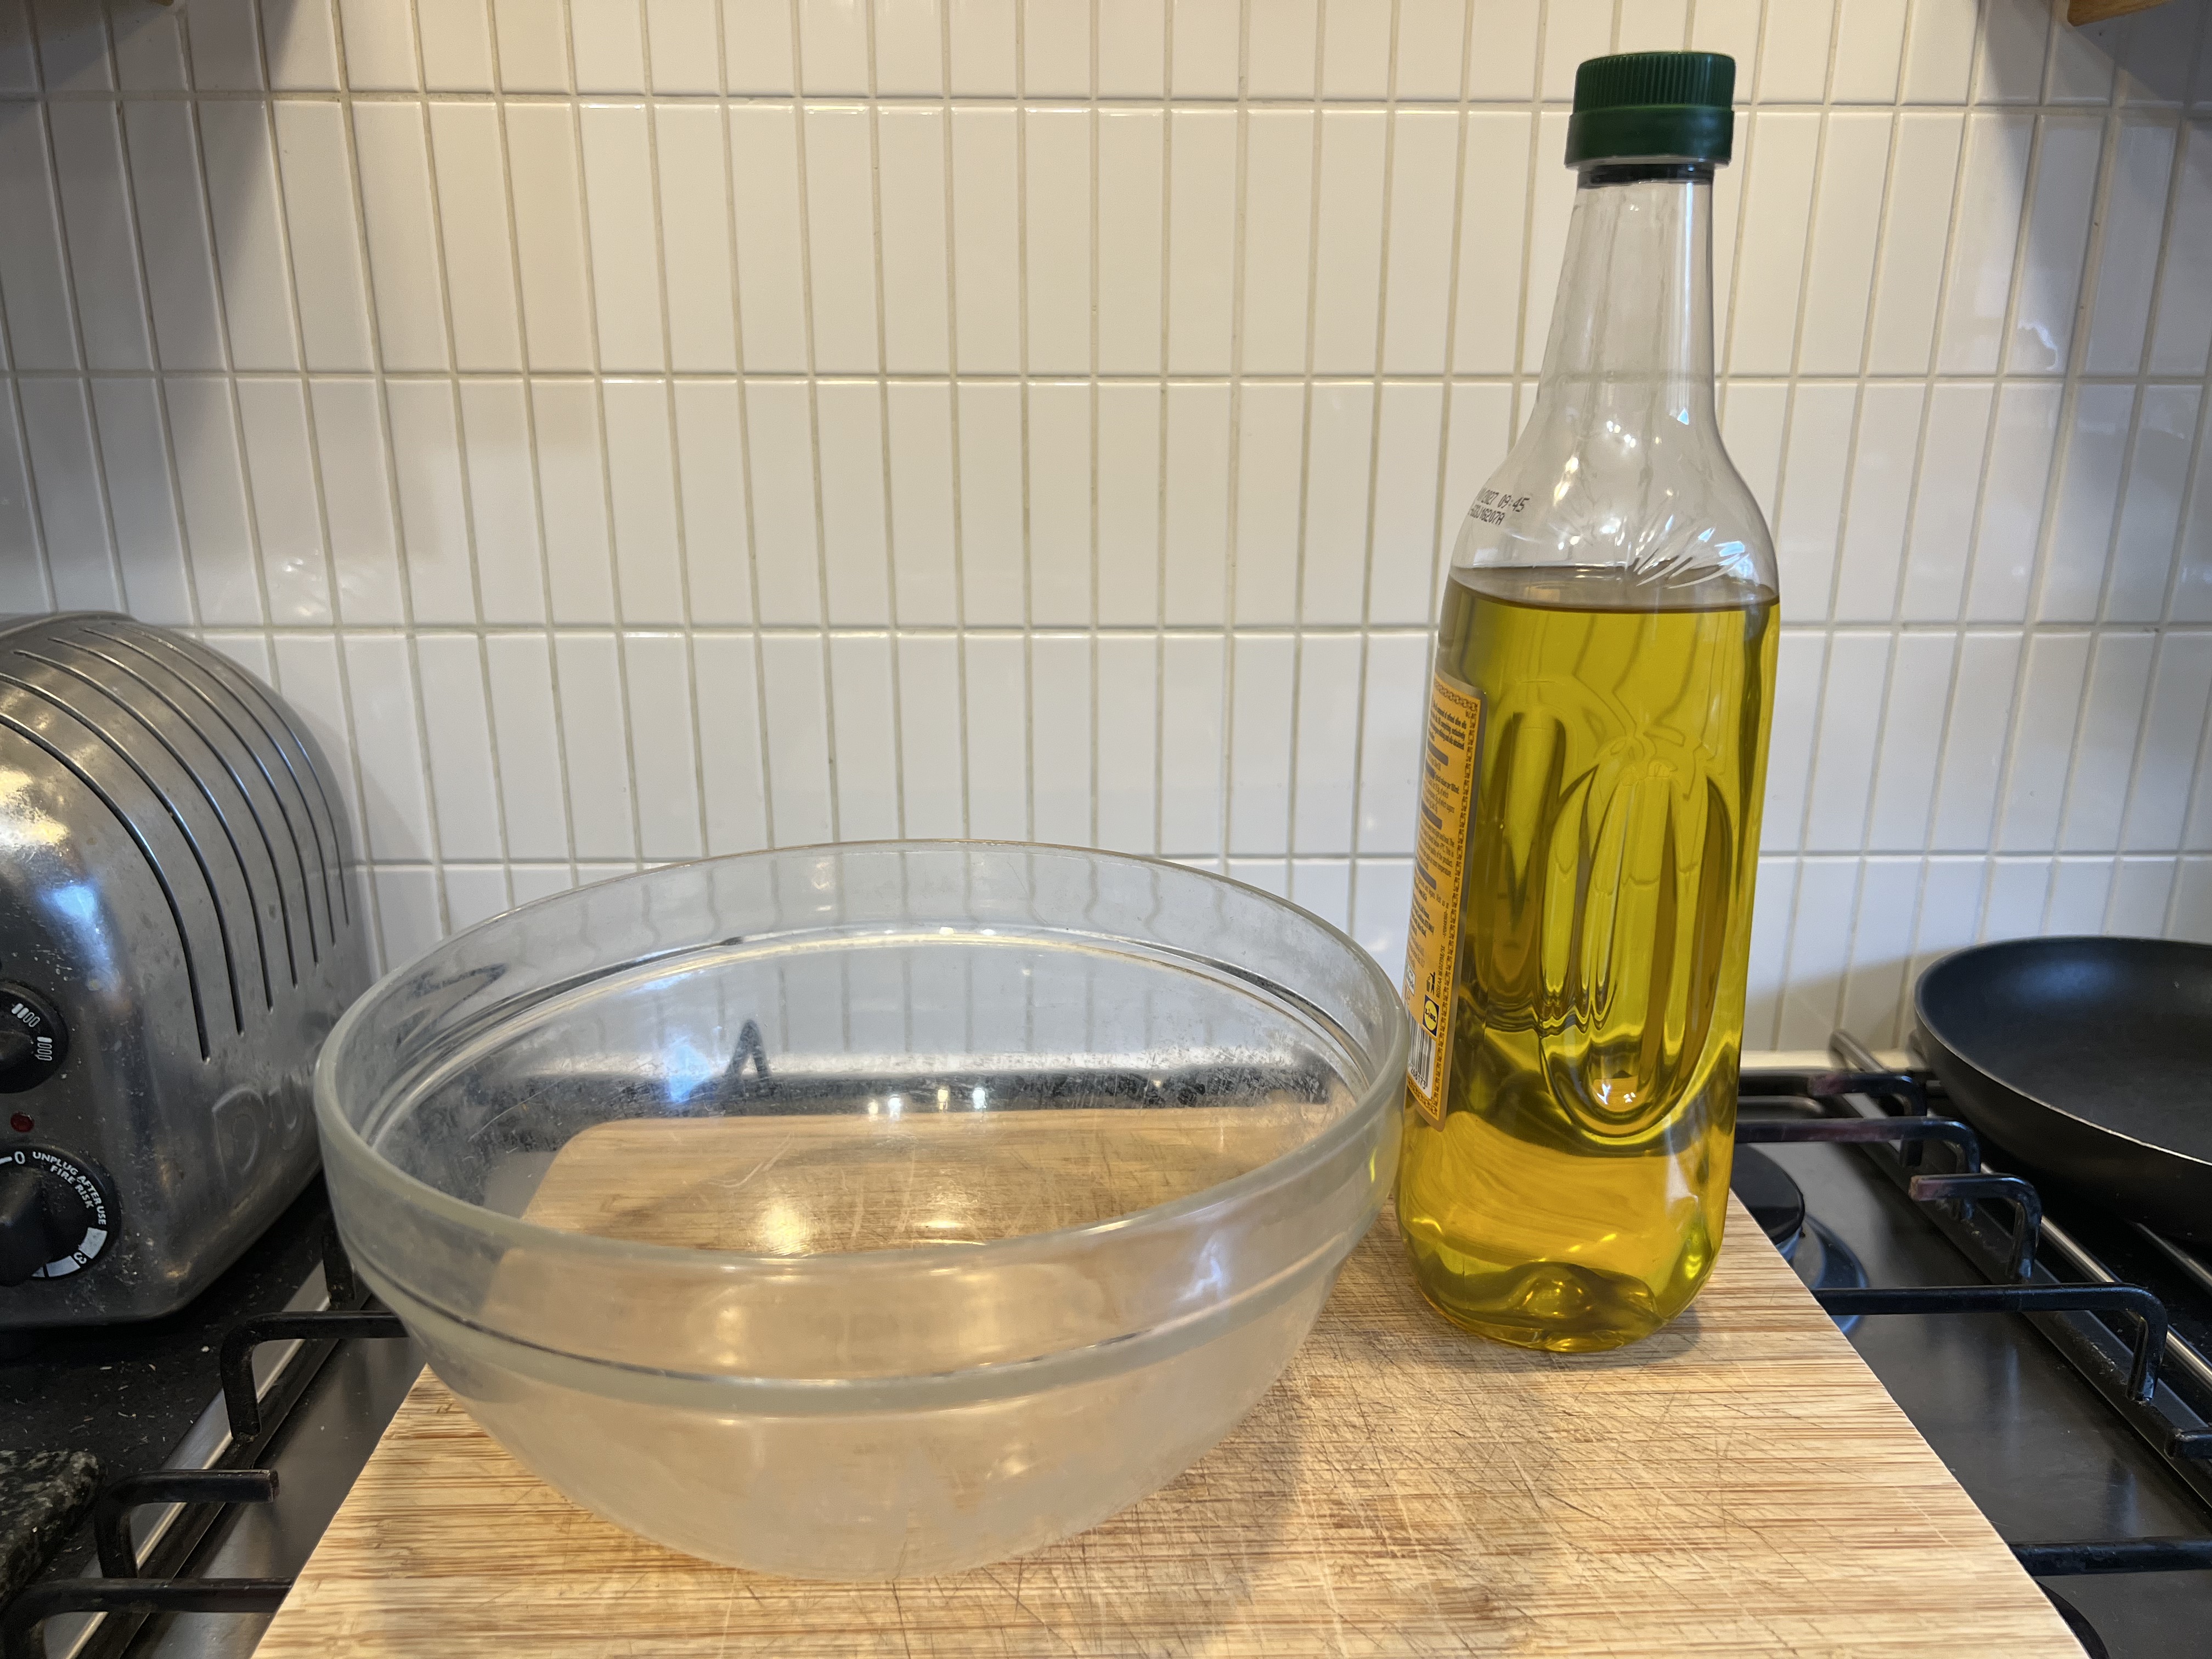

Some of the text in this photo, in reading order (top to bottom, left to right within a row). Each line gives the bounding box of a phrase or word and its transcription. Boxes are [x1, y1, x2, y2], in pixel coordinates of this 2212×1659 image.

[1497, 493, 1530, 512] 09:45
[14, 1151, 26, 1165] 0
[32, 1151, 106, 1225] UNPLUG AFTER USE
[50, 1165, 94, 1209] FIRE RISK
[73, 1251, 87, 1265] 3
